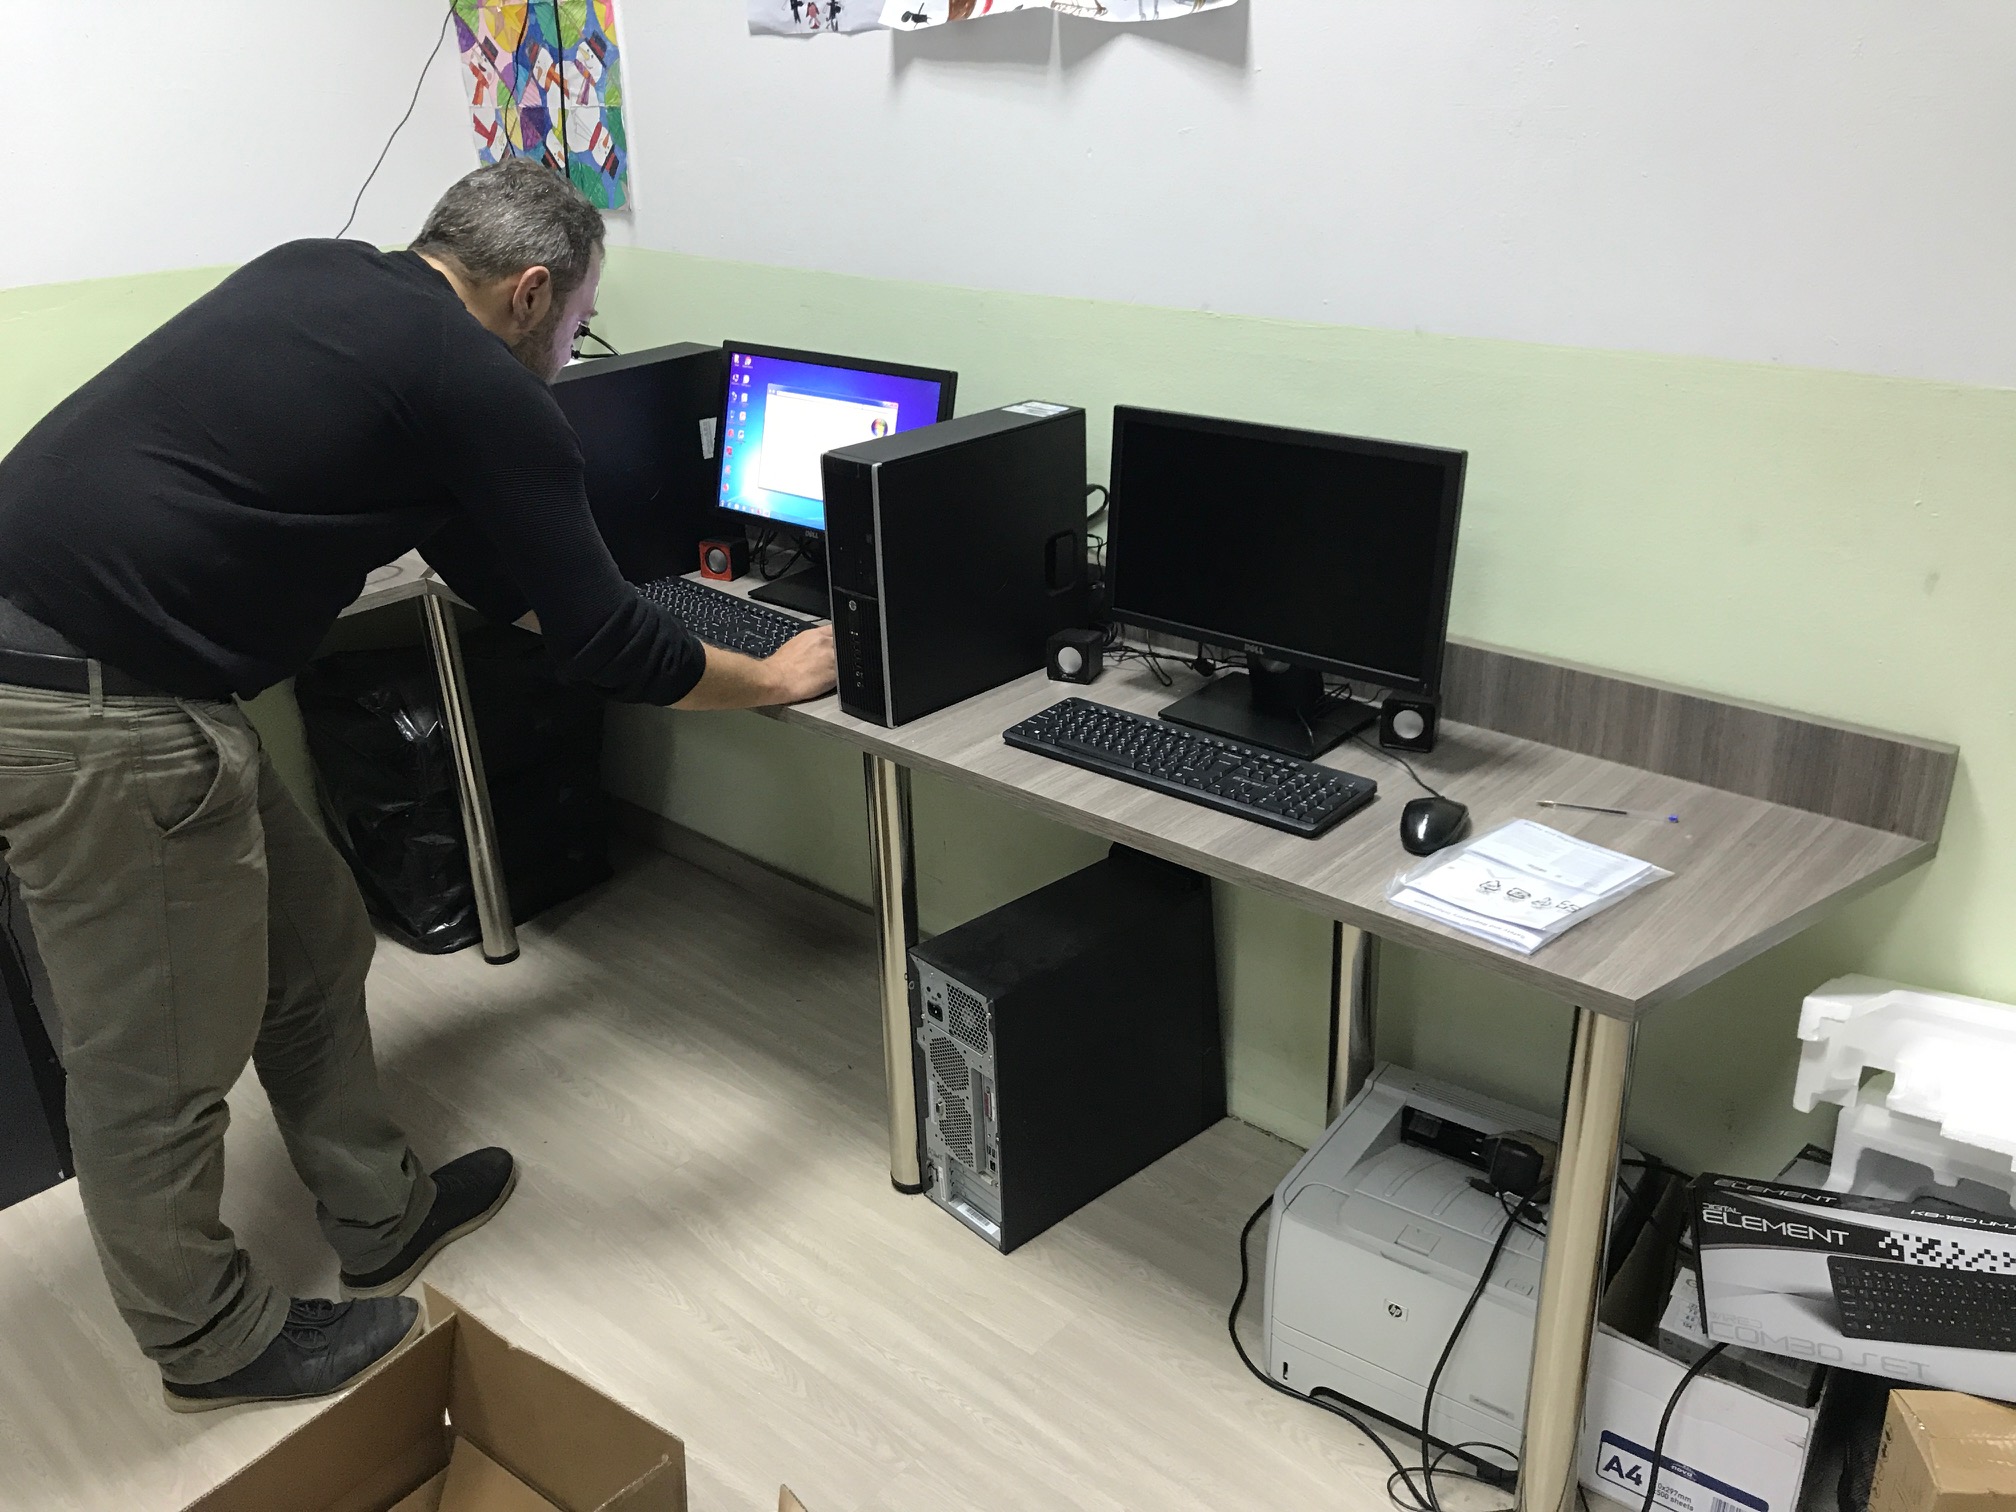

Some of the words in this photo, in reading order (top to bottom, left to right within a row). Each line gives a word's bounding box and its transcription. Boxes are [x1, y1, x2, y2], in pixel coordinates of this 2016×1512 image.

[1713, 1178, 1838, 1203] ELEMENT
[1702, 1202, 1742, 1215] DIGITAL
[1702, 1209, 1850, 1246] ELEMENT
[1709, 1321, 1843, 1362] COMBO
[1851, 1351, 1930, 1380] SET
[1602, 1454, 1644, 1487] A4
[1671, 1464, 1693, 1478] nova
[1657, 1482, 1692, 1503] 0x297mm
[1670, 1497, 1694, 1511] sheets
